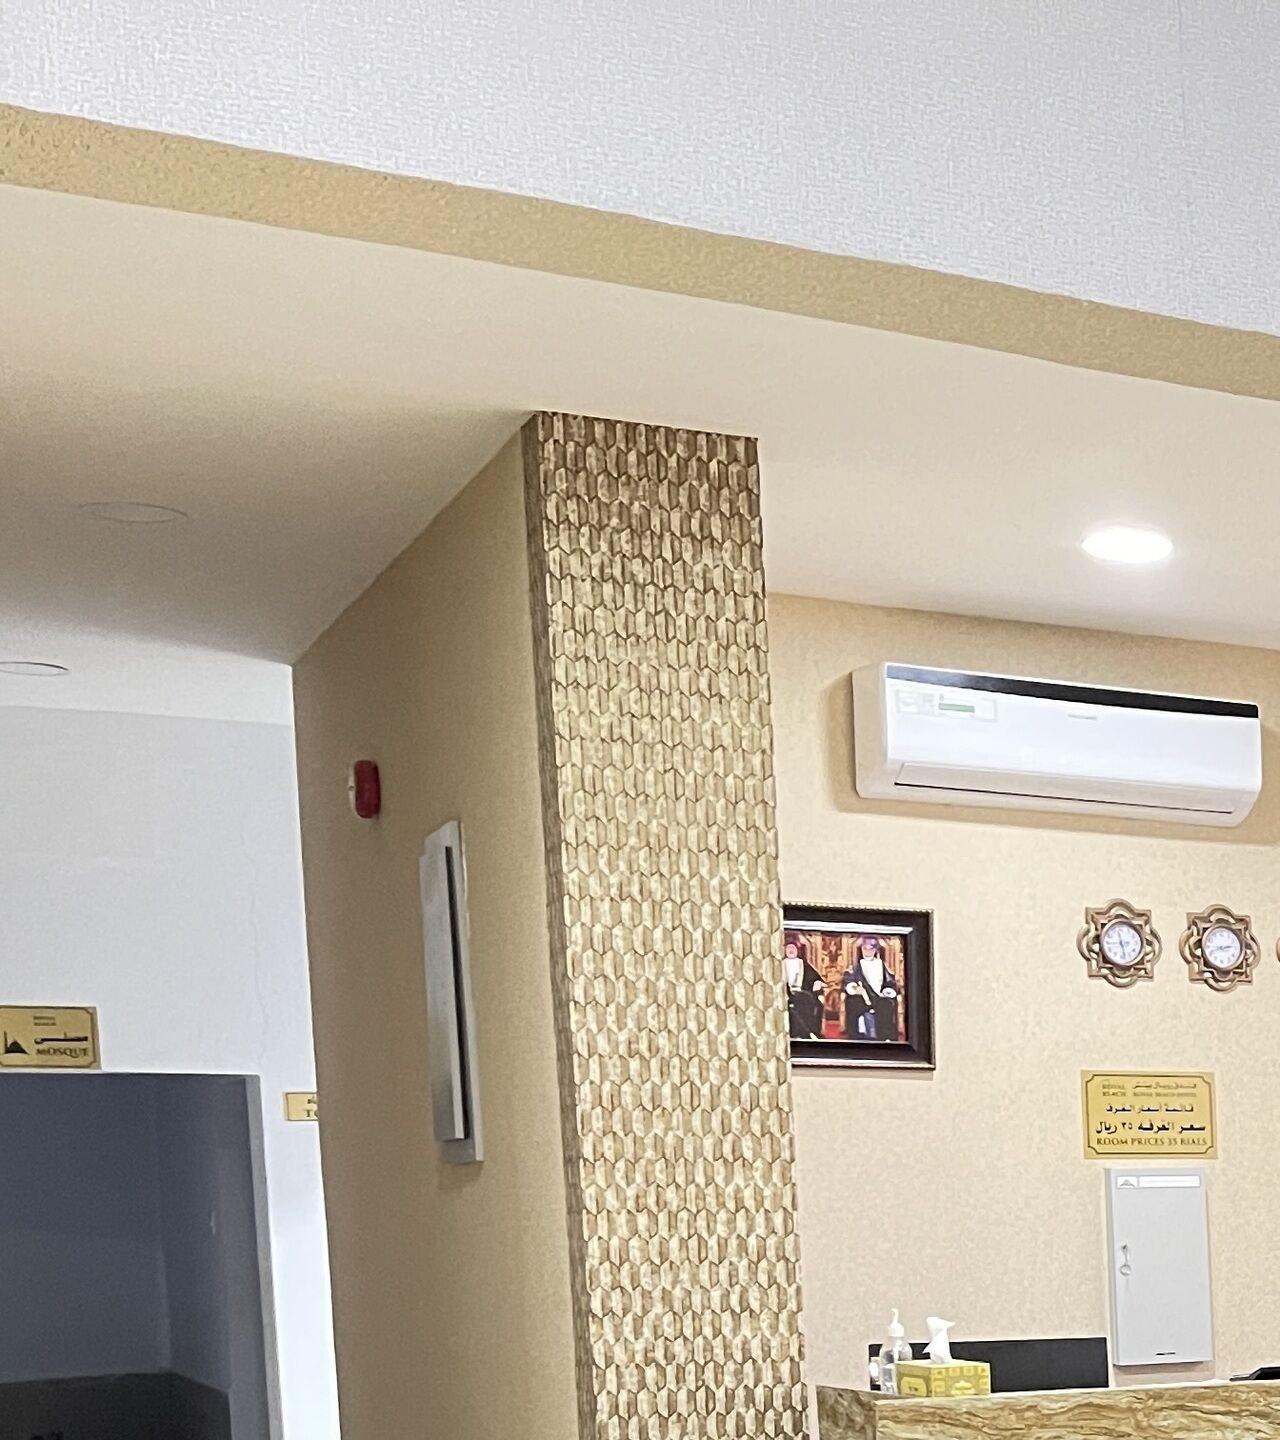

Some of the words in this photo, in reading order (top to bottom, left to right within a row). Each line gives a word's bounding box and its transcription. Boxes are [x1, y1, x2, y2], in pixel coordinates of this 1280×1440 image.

[36, 1047, 88, 1058] MOSQUE
[1096, 1121, 1118, 1134] ريال
[1178, 1124, 1206, 1134] سعر
[1096, 1137, 1129, 1146] ROOM
[1131, 1138, 1164, 1146] PRICES
[1167, 1138, 1178, 1146] 35
[1180, 1138, 1207, 1146] RIALS
